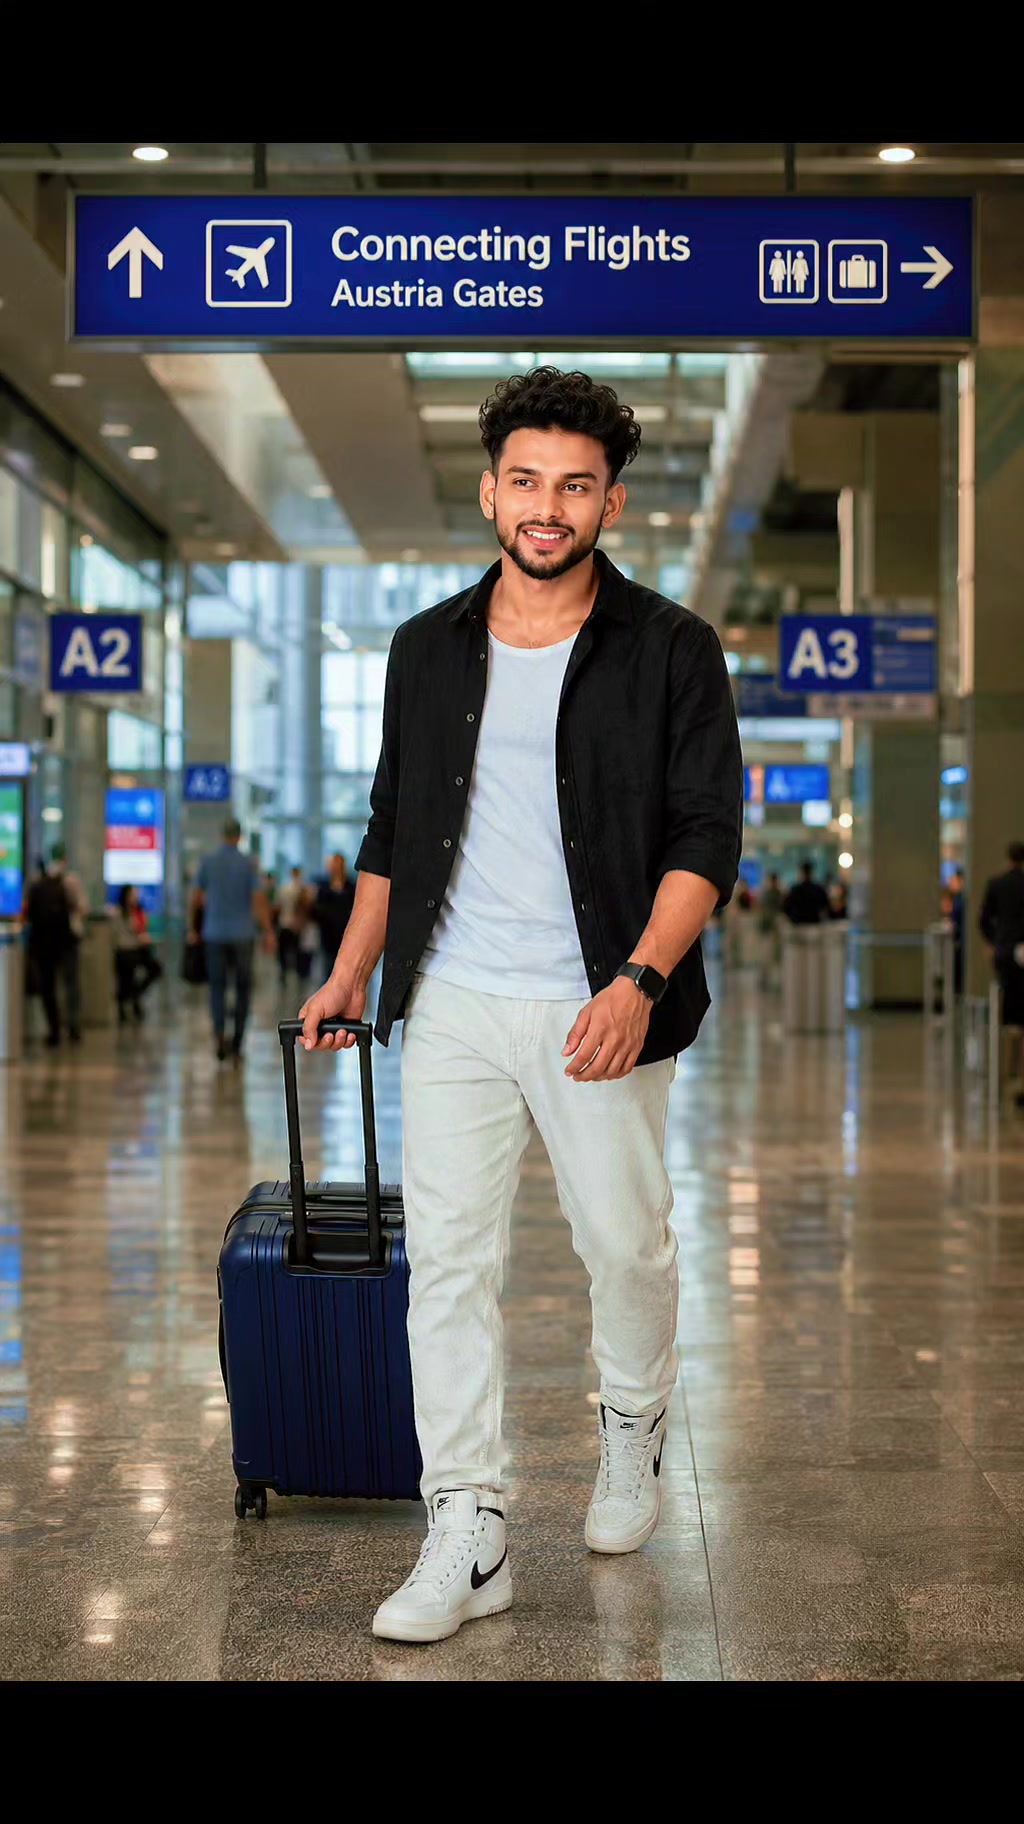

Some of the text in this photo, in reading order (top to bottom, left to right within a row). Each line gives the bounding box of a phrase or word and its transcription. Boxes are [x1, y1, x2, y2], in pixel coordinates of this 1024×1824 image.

[330, 225, 691, 271] Connecting Flights
[330, 278, 544, 308] Austria Gates
[60, 627, 130, 677] A2
[788, 628, 860, 679] A3
